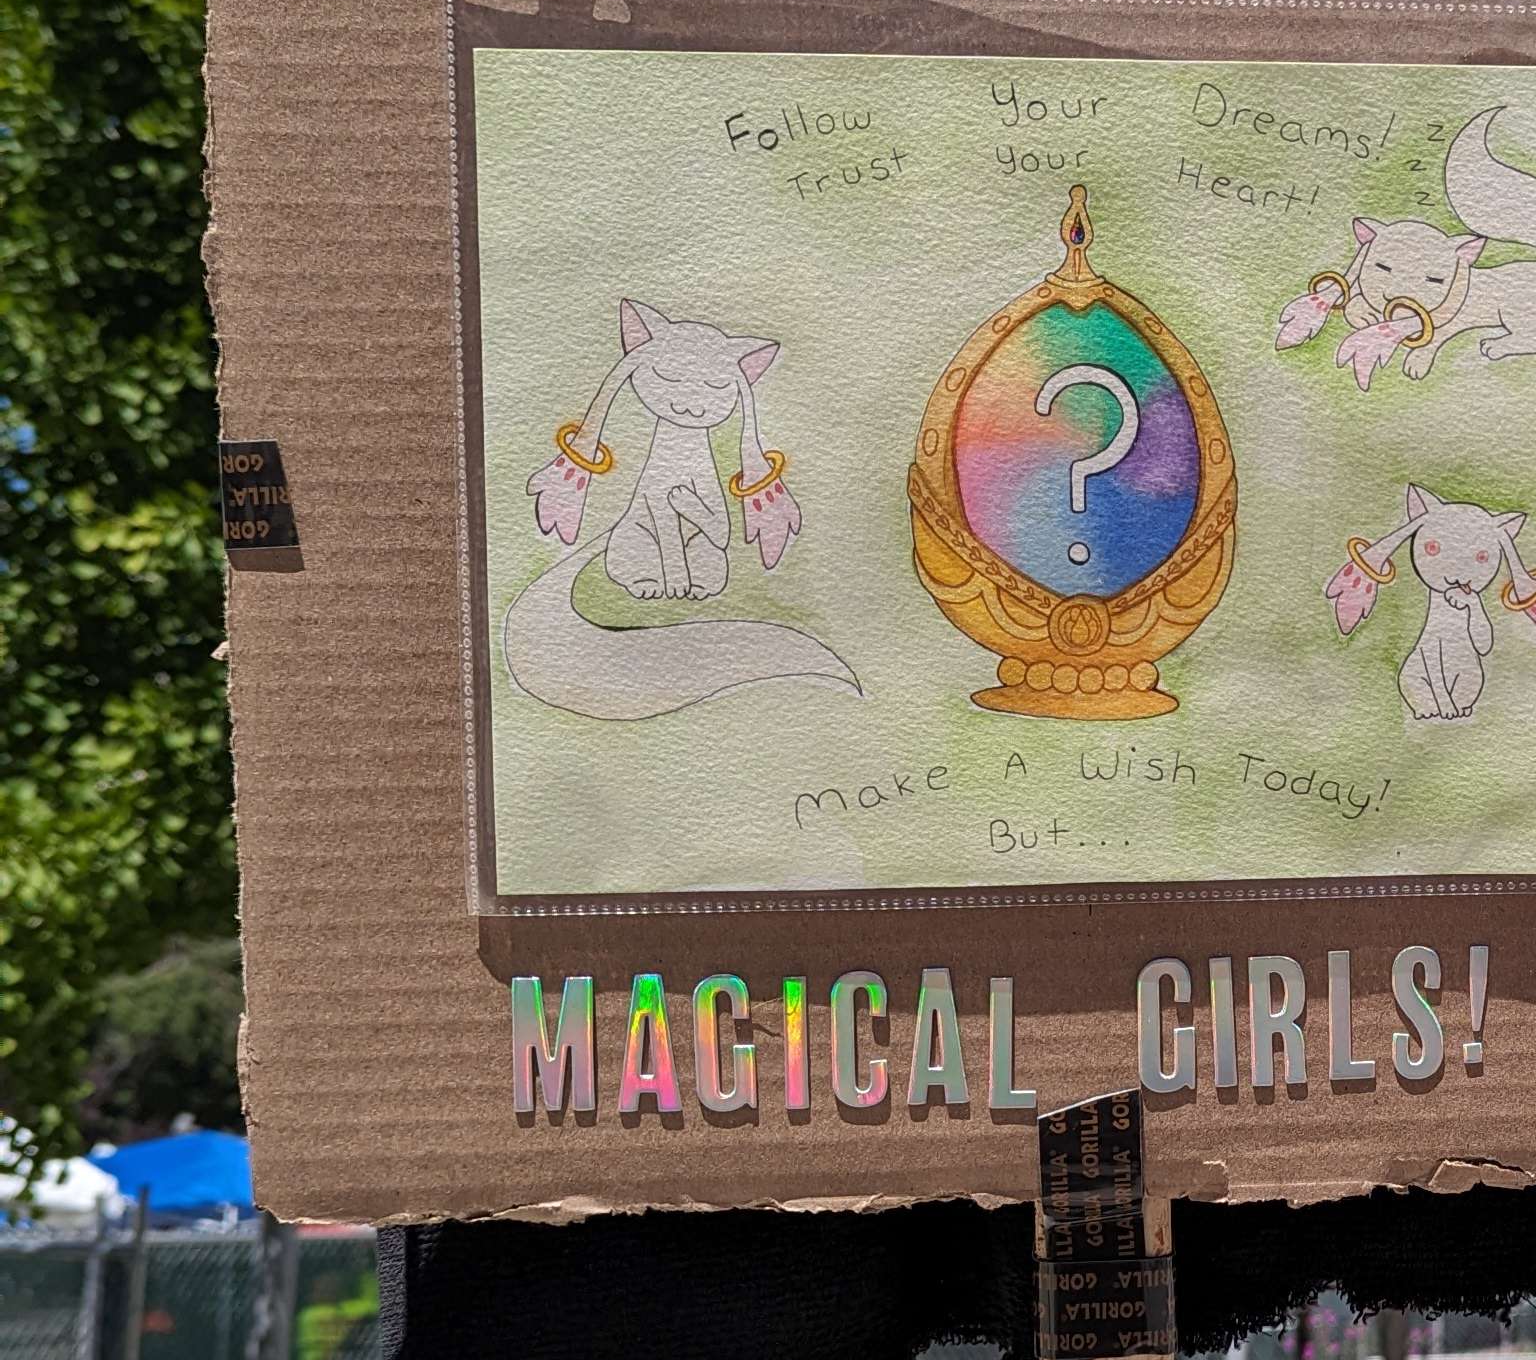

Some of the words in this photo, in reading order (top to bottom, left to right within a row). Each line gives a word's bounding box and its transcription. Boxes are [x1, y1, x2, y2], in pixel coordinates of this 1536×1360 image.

[723, 103, 873, 154] Follow
[990, 81, 1109, 127] Your
[1191, 81, 1397, 161] Dreams!
[786, 146, 910, 202] Trust
[1176, 154, 1320, 216] Heart!
[1034, 363, 1141, 566] ?
[1003, 751, 1029, 781] A
[1079, 746, 1197, 785] Wish
[1237, 753, 1392, 821] Today!
[511, 967, 1037, 1114] MAGICAL
[1137, 944, 1490, 1094] GIRLS!
[1065, 1301, 1147, 1321] GORILLA
